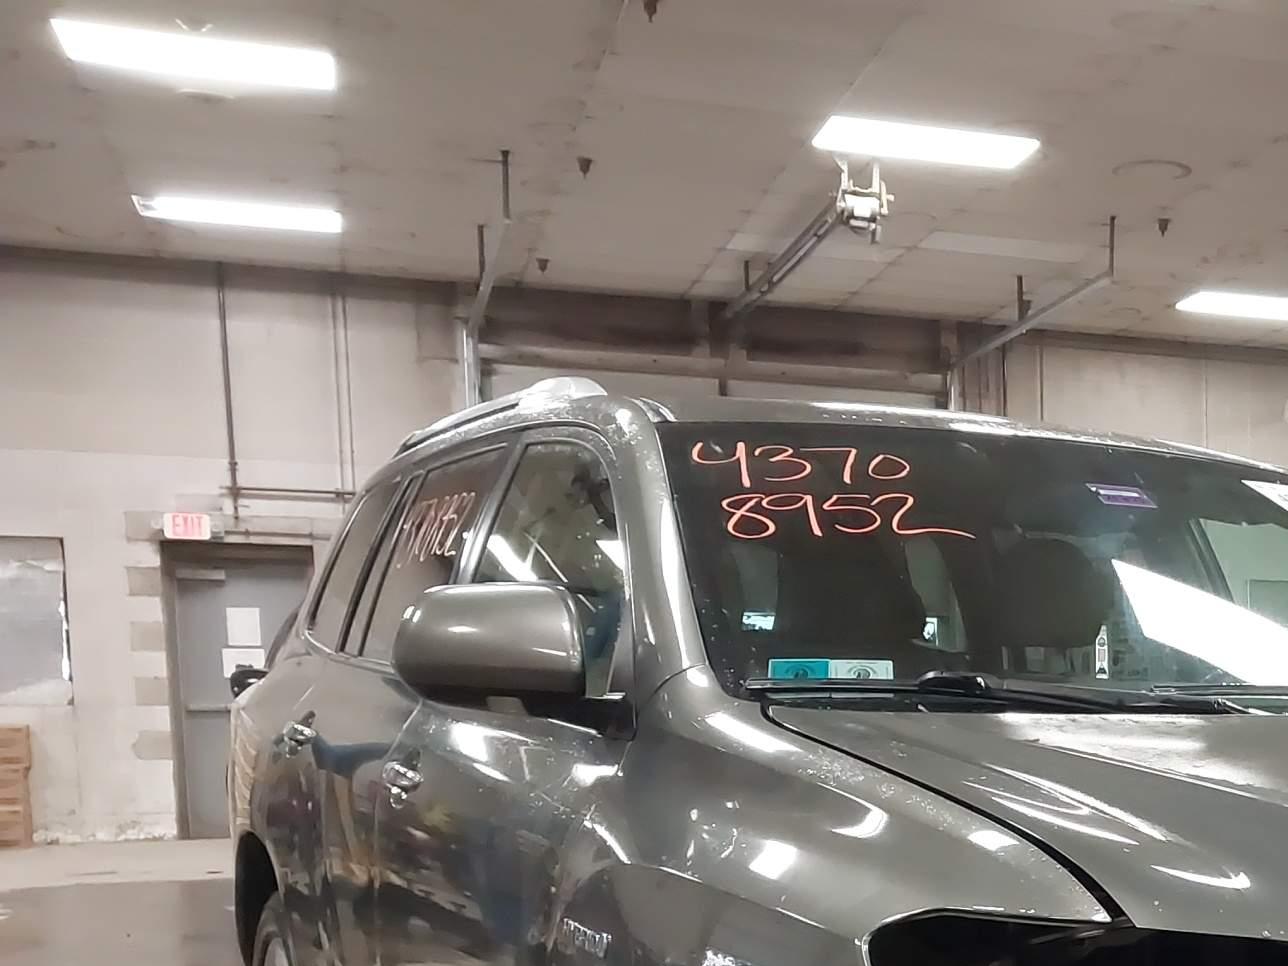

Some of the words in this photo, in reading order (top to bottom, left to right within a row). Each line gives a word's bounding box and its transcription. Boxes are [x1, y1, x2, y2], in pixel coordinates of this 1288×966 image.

[691, 441, 910, 488] 4370
[172, 514, 205, 538] EXIT
[721, 493, 977, 539] 8952
